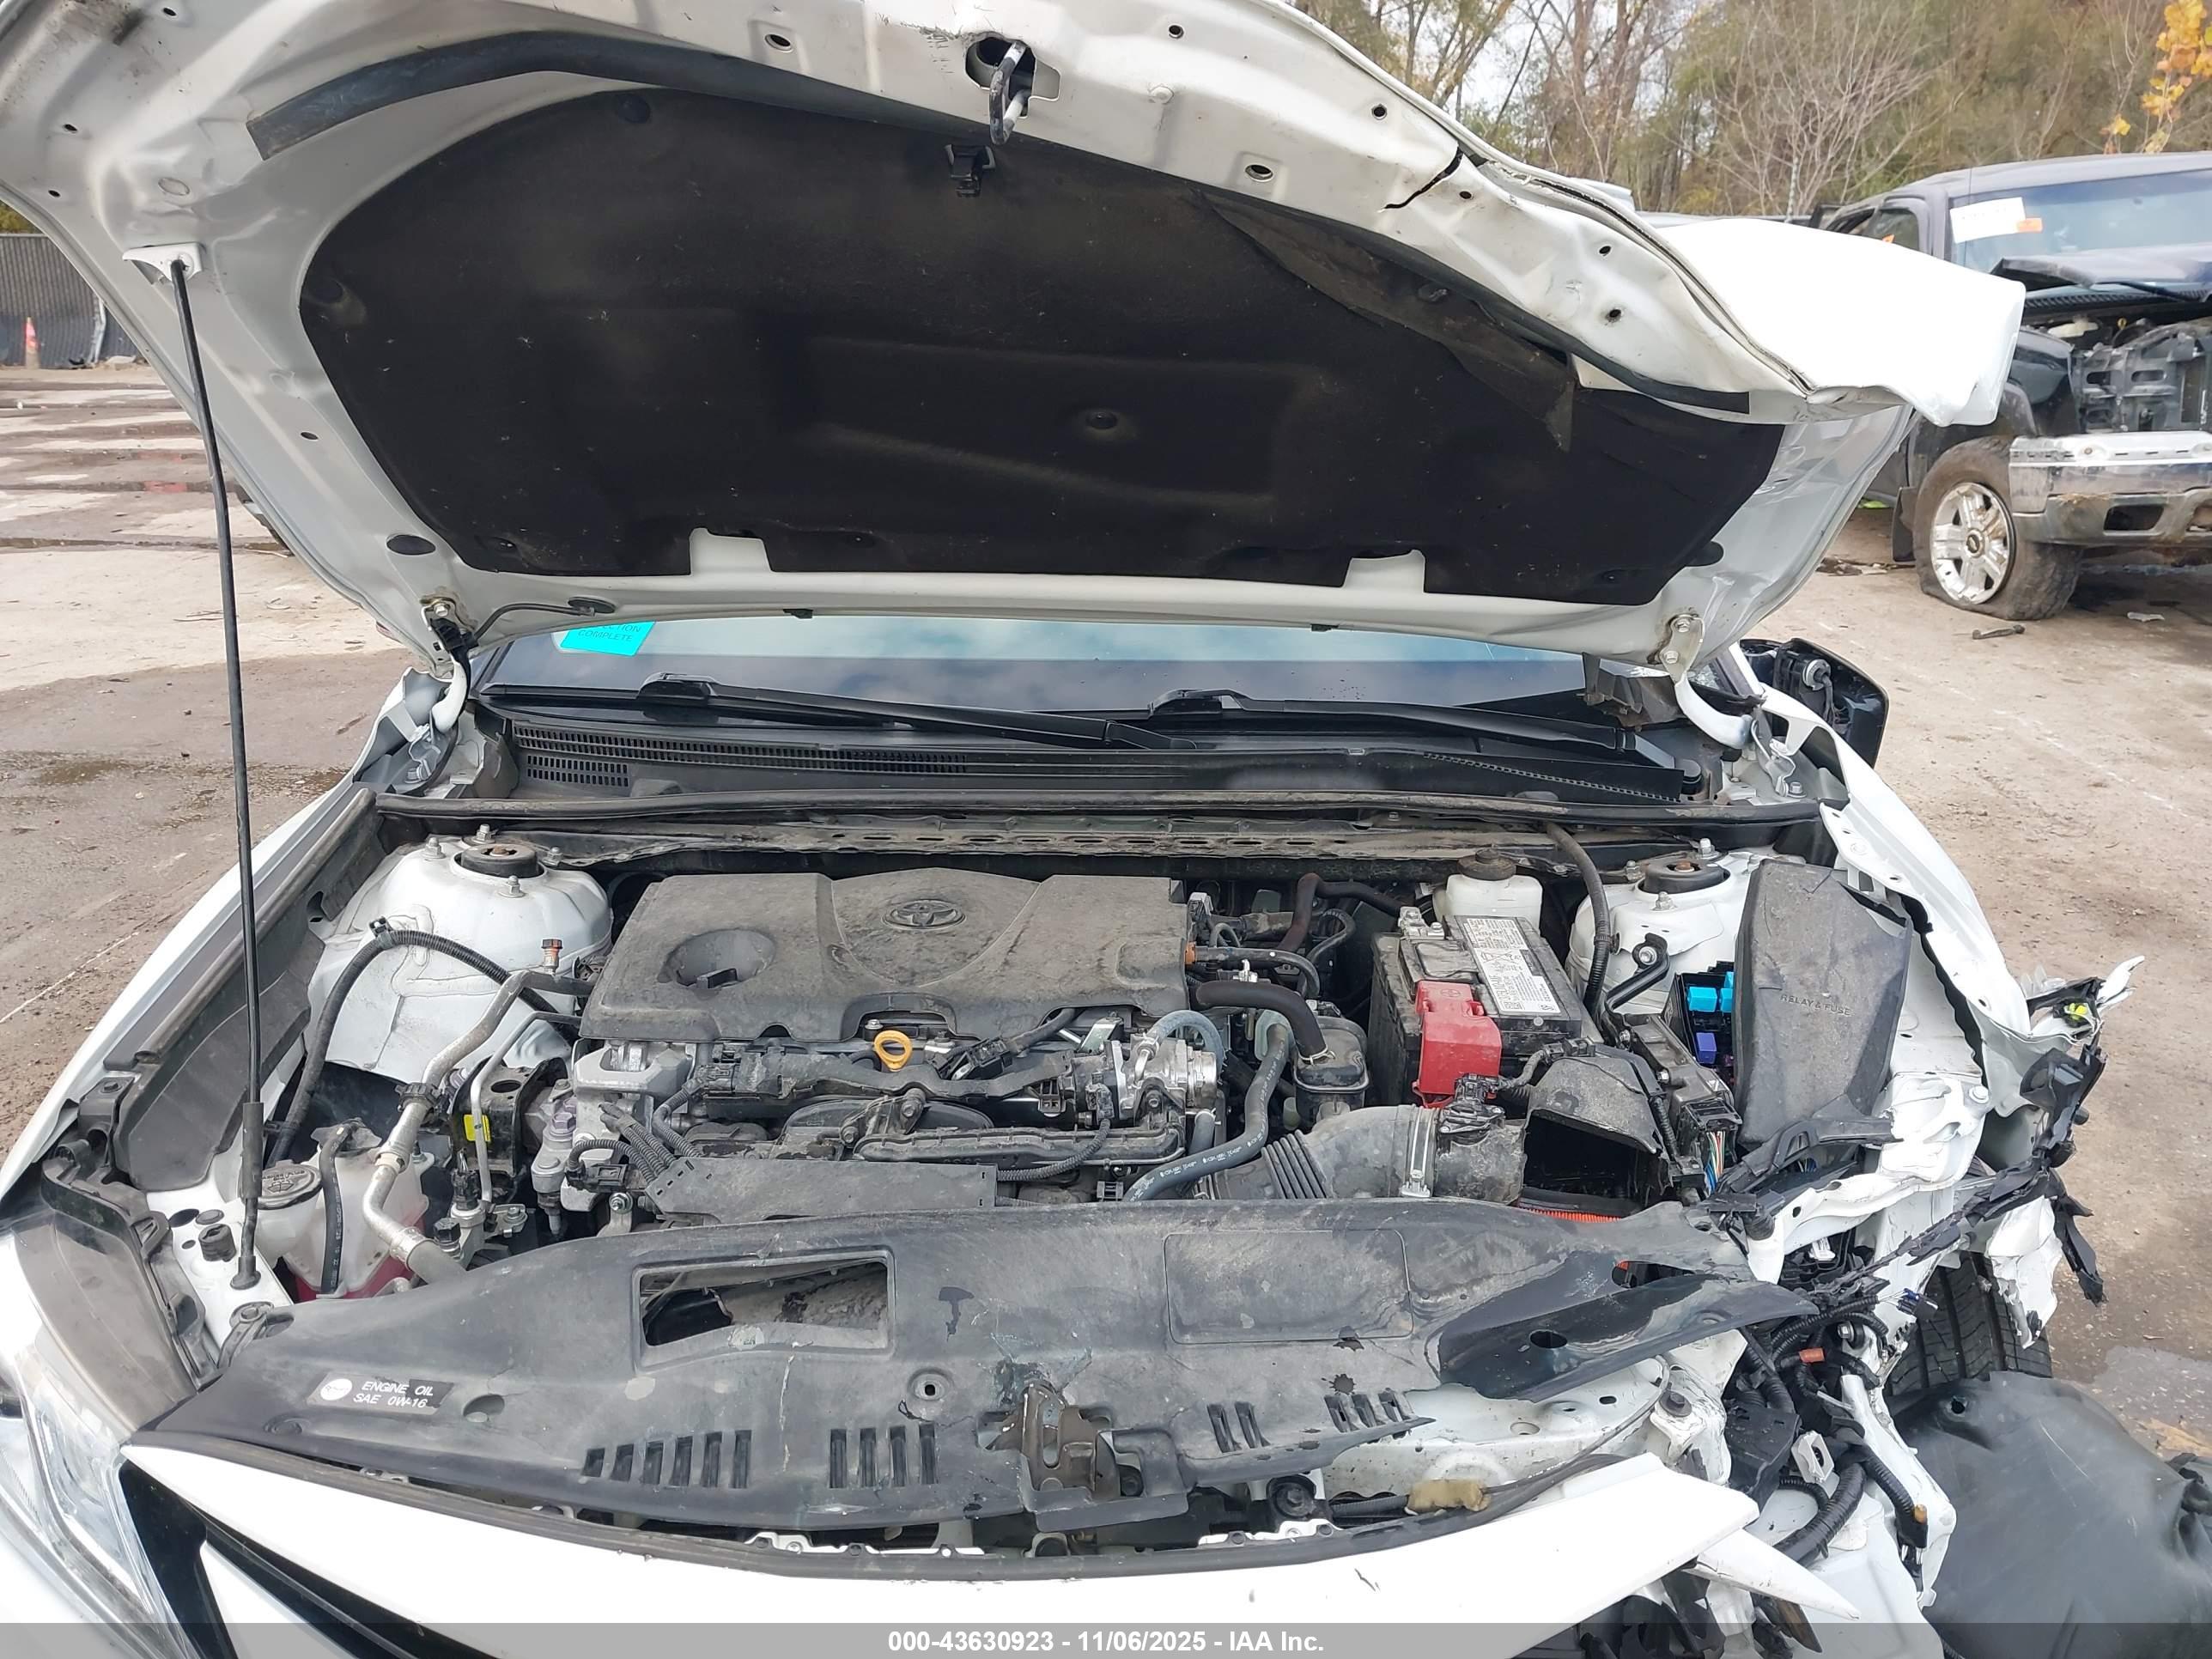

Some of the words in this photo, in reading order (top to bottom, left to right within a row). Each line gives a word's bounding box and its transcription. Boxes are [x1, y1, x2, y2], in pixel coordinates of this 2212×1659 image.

[578, 629, 633, 642] COMPLETE
[1780, 994, 1814, 1007] RELAY
[1823, 1003, 1852, 1016] FUSE
[362, 1381, 410, 1395] ENGINE
[414, 1385, 434, 1396] OIL
[353, 1393, 381, 1404] SAE
[387, 1396, 428, 1408] 0W-16
